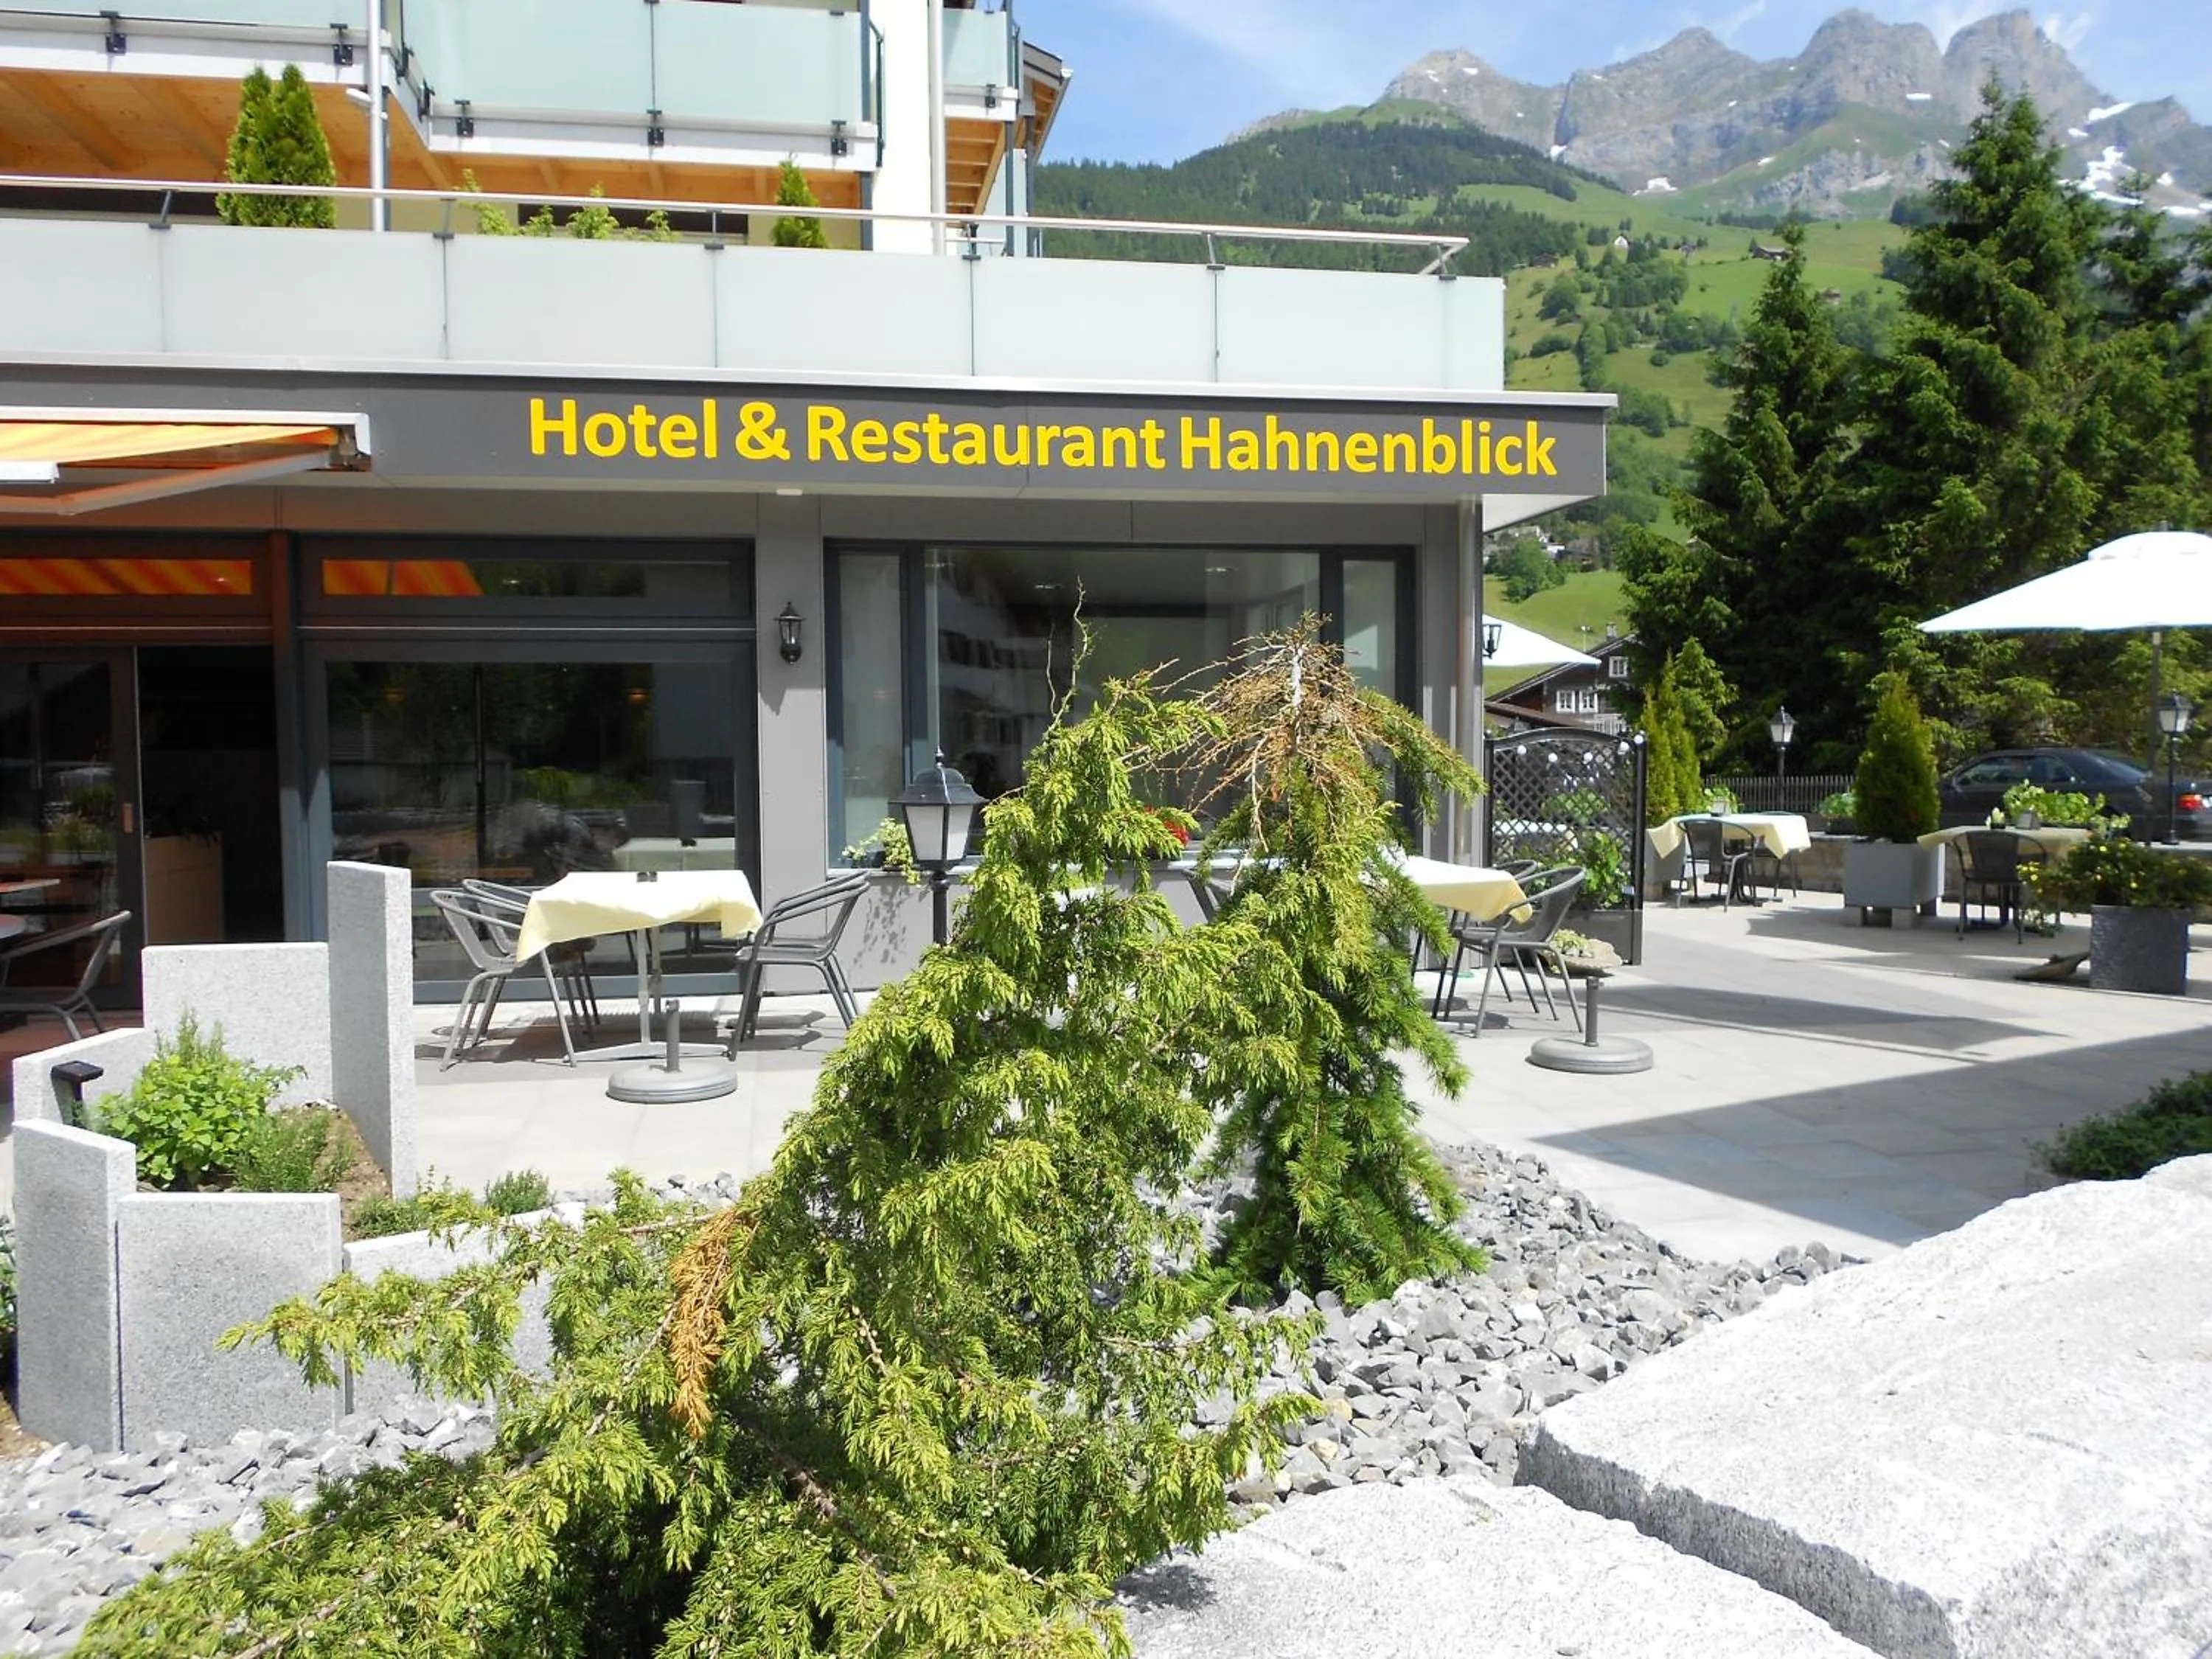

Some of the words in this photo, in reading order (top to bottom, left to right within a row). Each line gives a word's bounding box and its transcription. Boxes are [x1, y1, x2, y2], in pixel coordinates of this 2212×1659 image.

[529, 397, 719, 460] Hotel
[734, 400, 792, 462] &
[806, 404, 1167, 471] Restaurant
[1178, 414, 1559, 478] Hahnenblick
